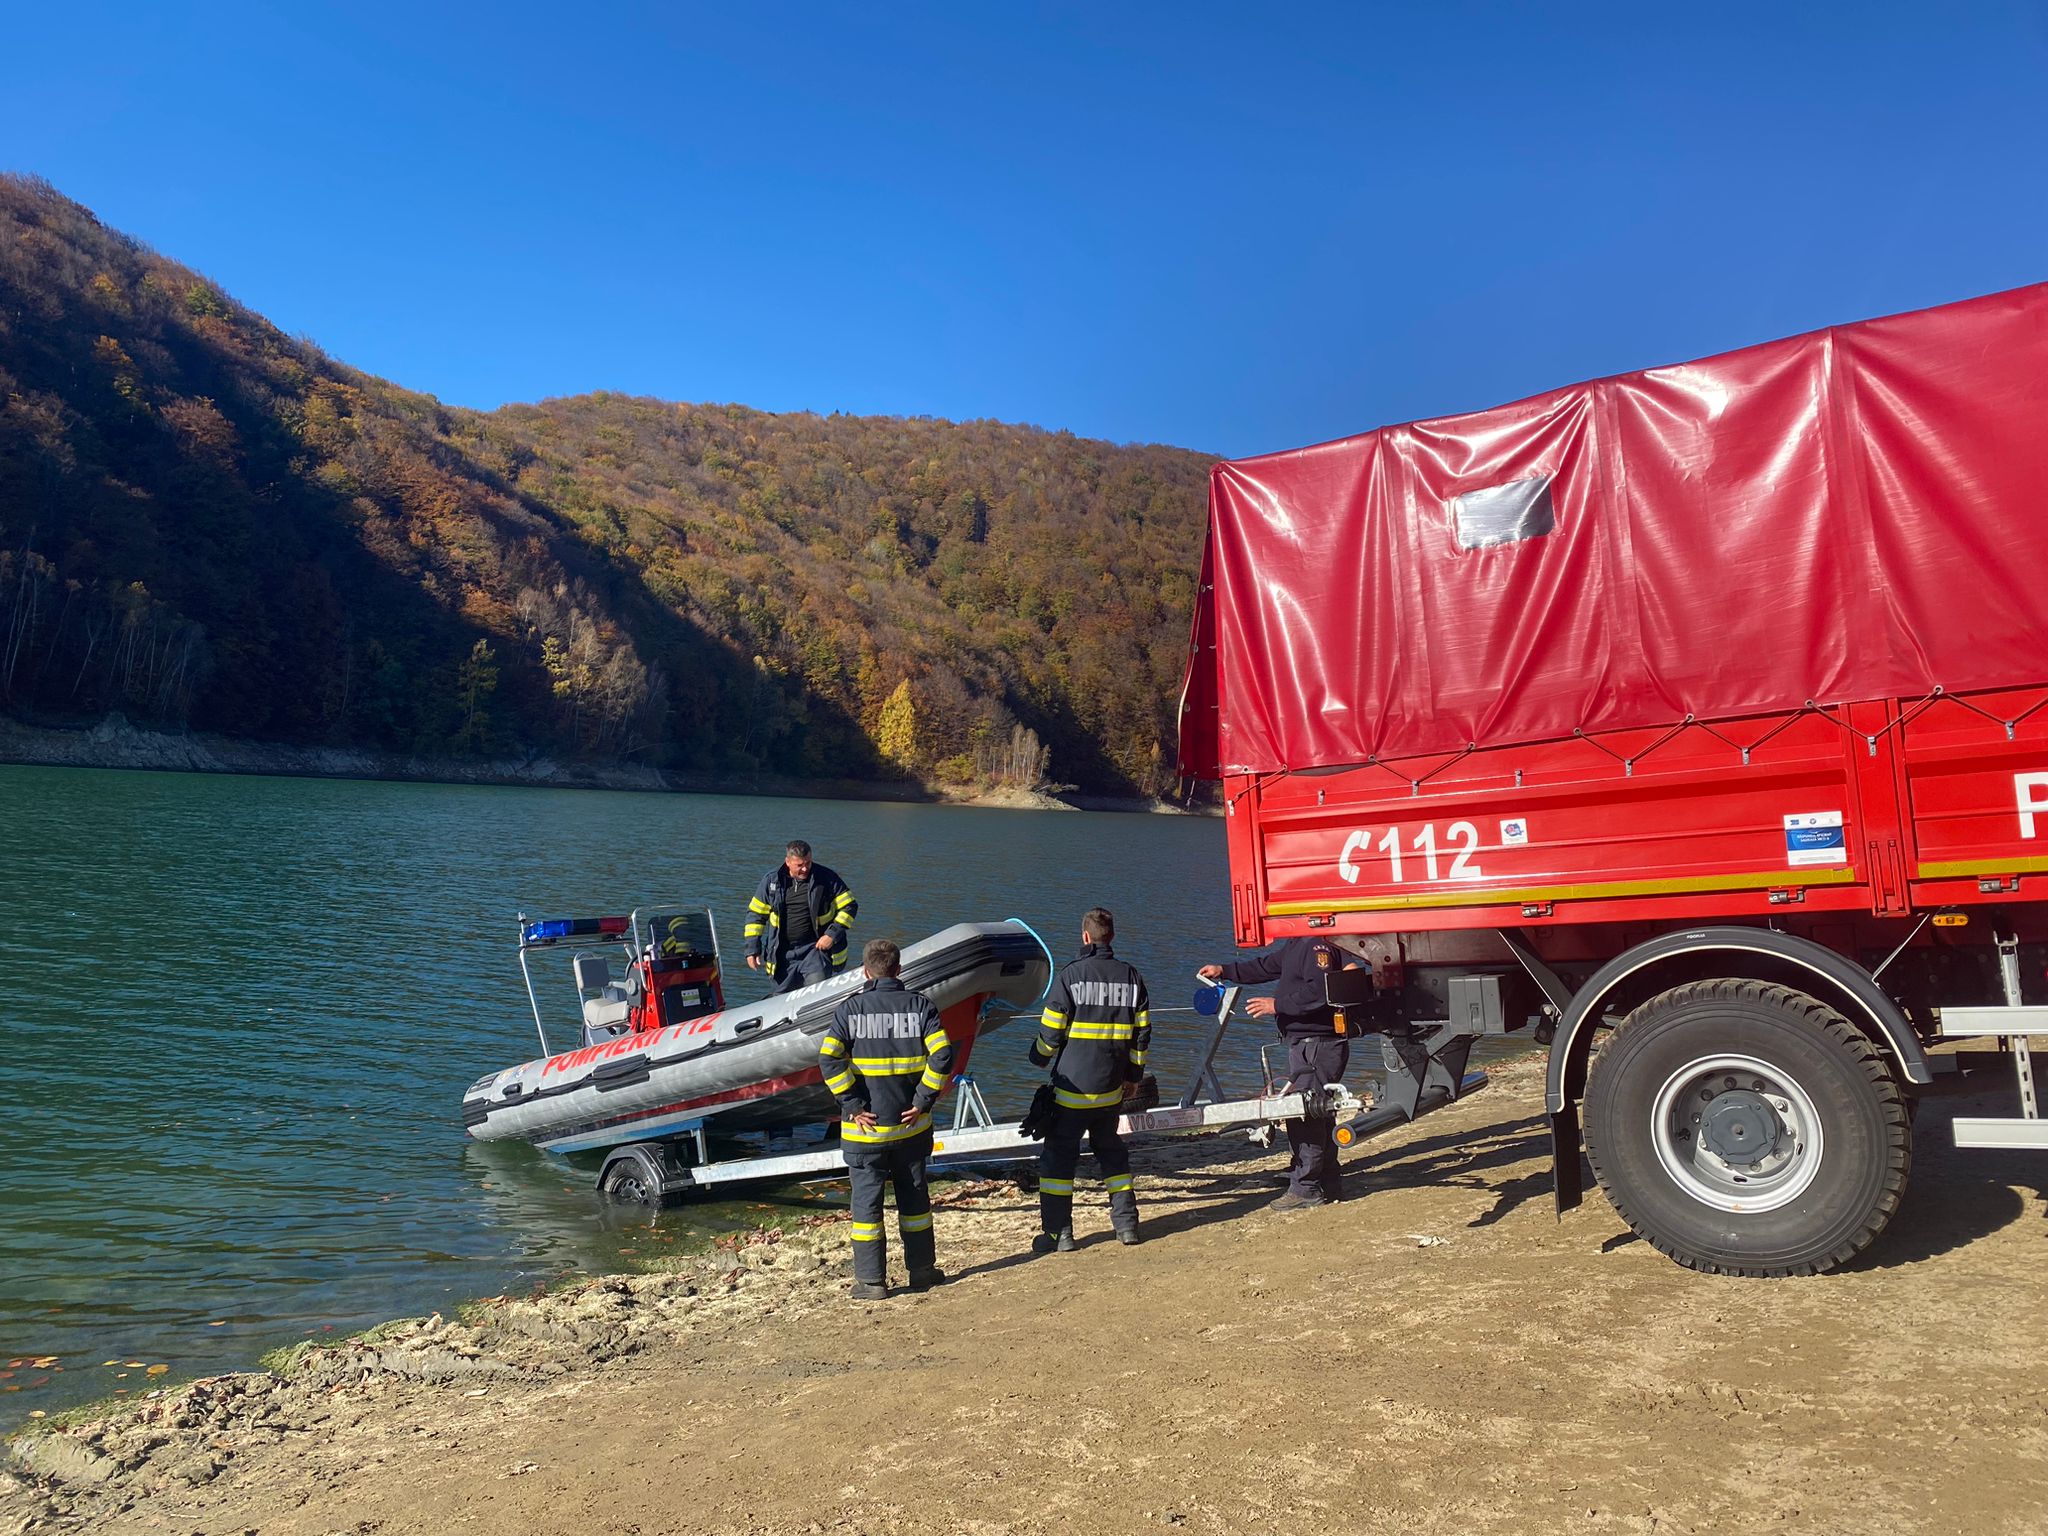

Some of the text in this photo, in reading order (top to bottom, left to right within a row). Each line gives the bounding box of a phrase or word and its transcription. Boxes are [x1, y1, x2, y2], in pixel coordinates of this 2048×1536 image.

[2014, 771, 2048, 839] P
[1379, 821, 1482, 883] 112
[672, 1012, 722, 1040] 112
[848, 1012, 922, 1040] POMPIER
